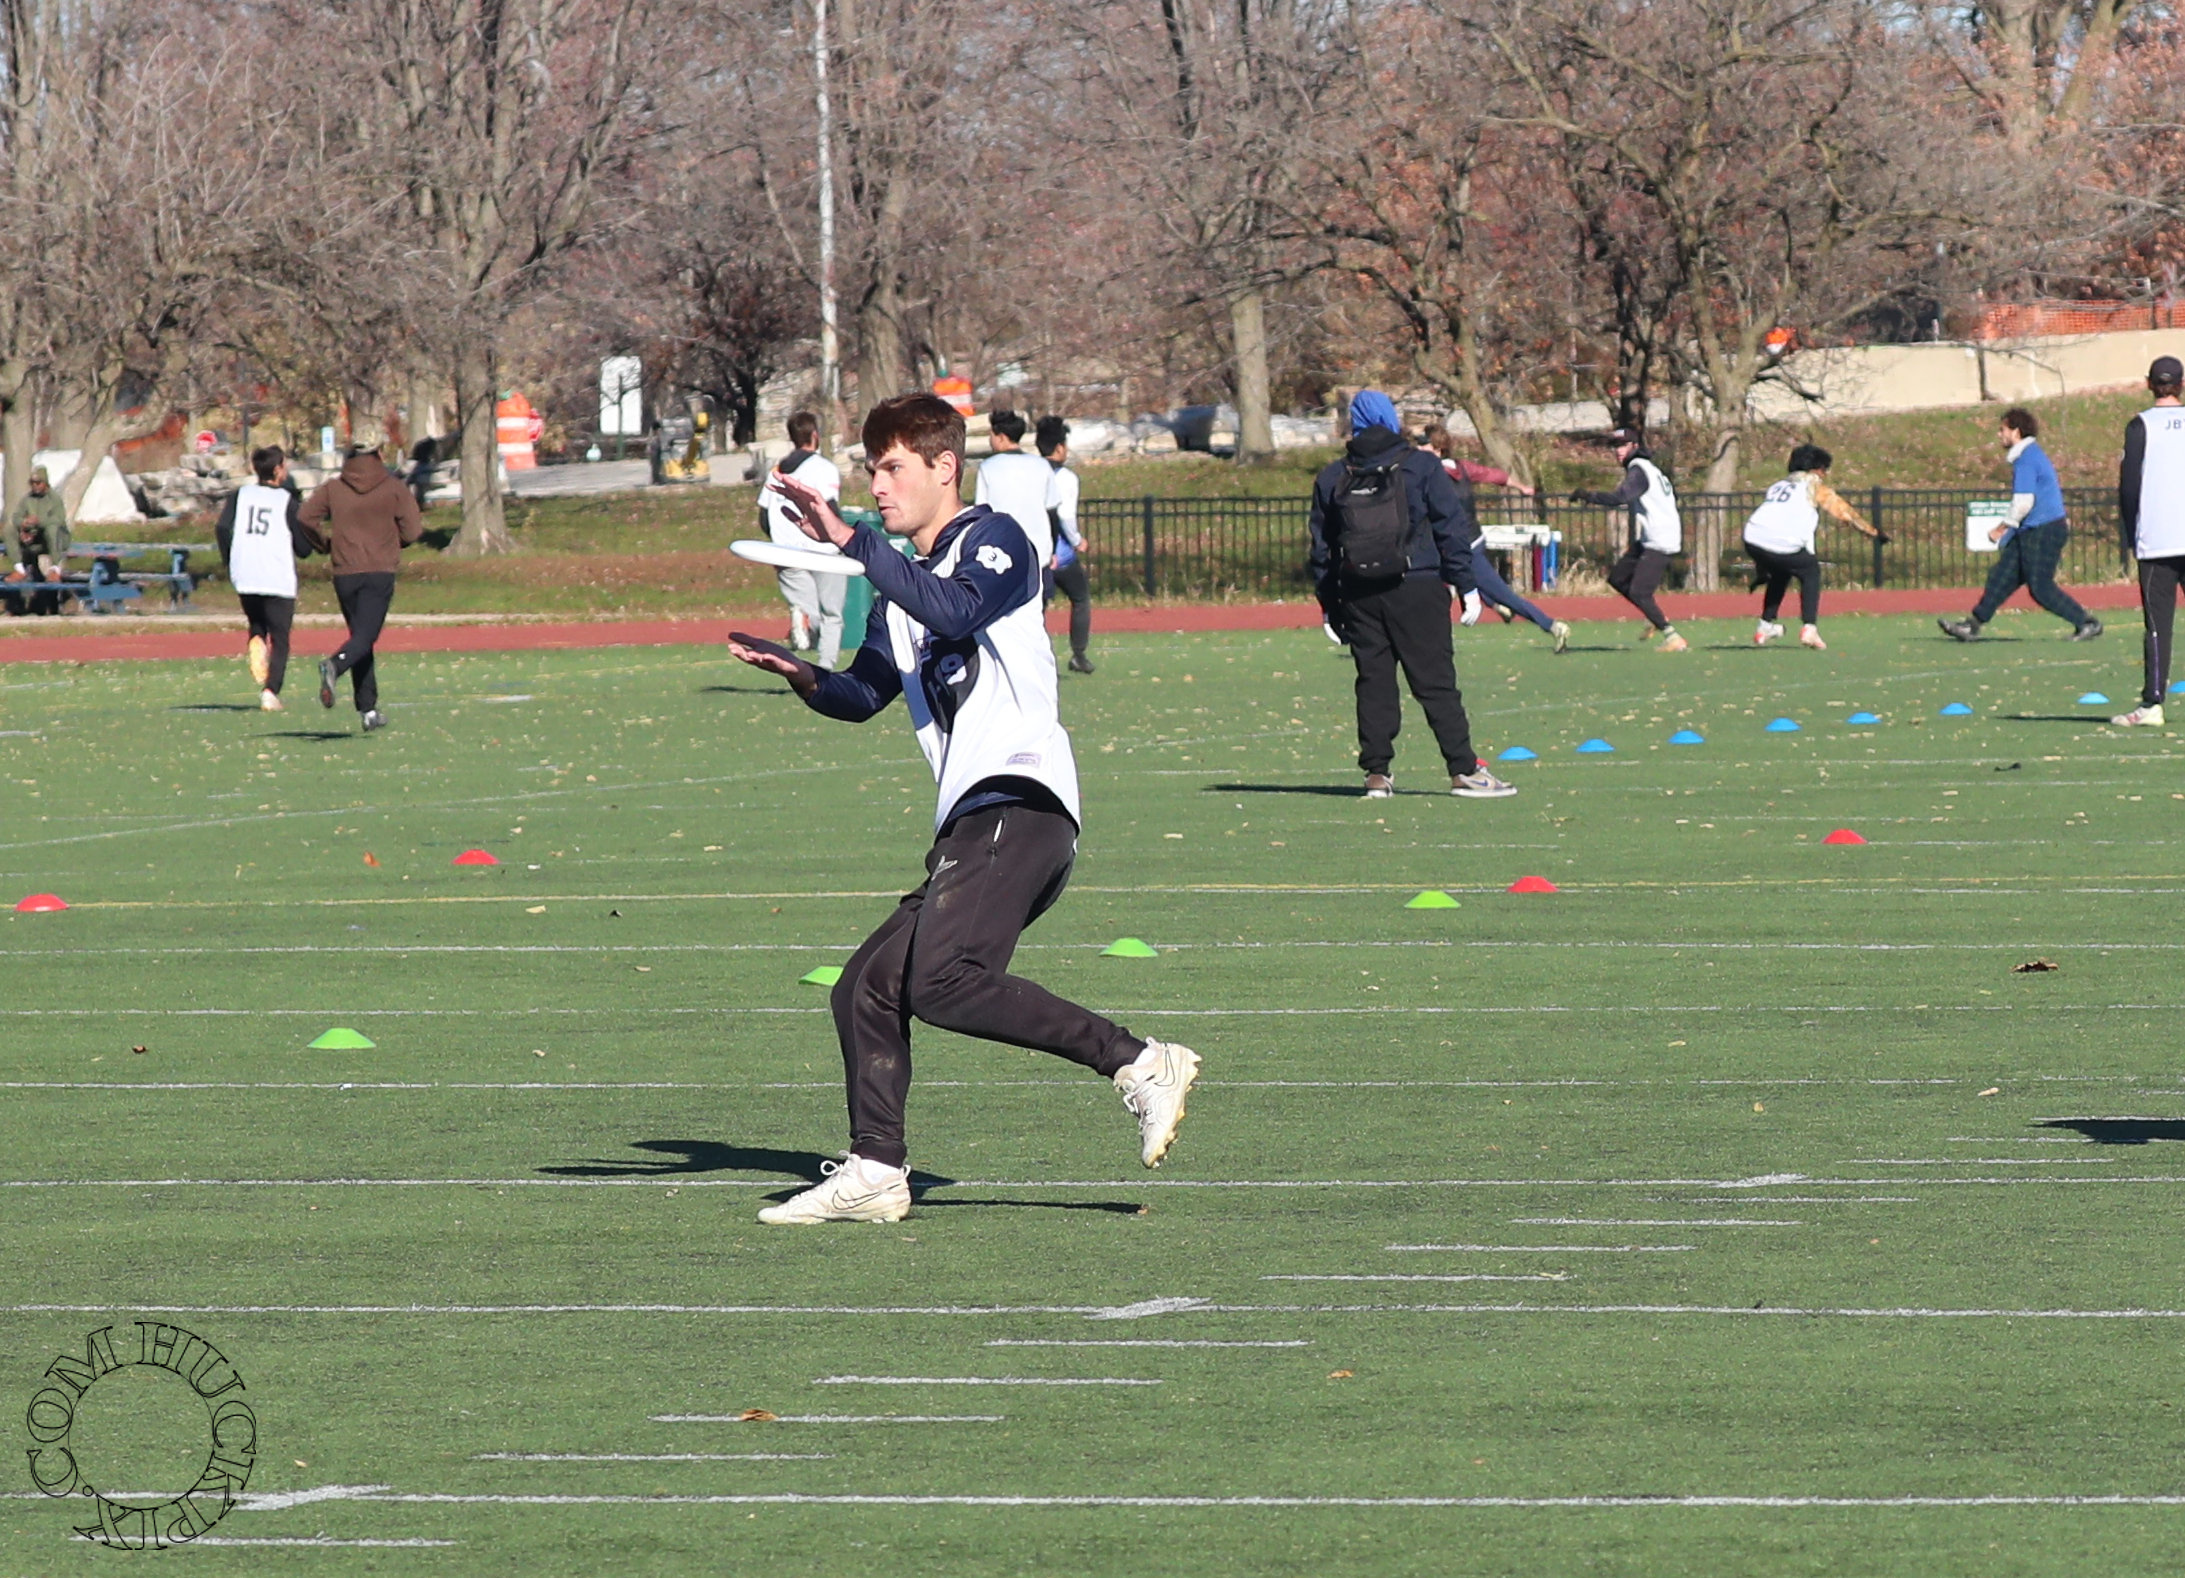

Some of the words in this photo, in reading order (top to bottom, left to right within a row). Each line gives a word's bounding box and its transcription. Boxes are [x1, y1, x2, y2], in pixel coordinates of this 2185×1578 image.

[2165, 418, 2185, 430] JB
[1764, 483, 1797, 503] 26
[246, 505, 272, 536] 15
